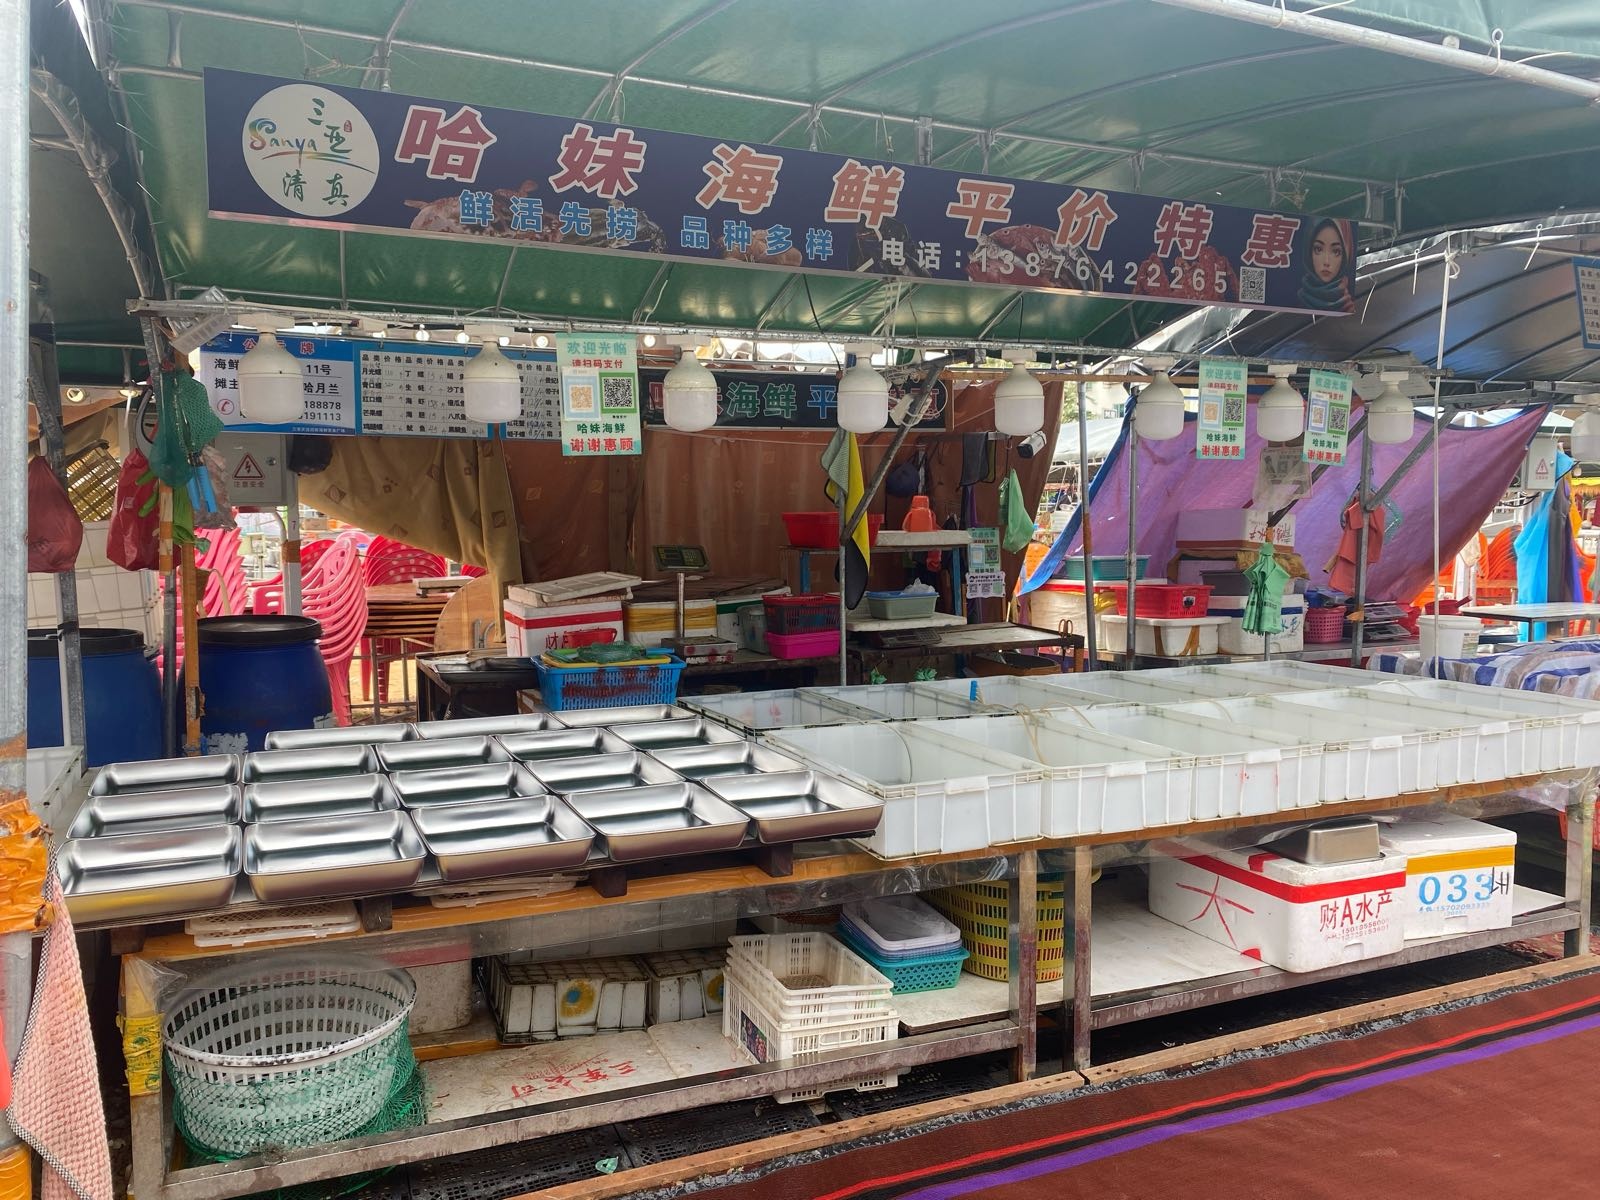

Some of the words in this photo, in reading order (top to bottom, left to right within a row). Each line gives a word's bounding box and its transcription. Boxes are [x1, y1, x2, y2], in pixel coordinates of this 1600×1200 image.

[249, 118, 317, 168] Sanya
[283, 169, 349, 206] 清真
[395, 105, 1299, 269] 哈妹海鲜平价特惠
[459, 189, 638, 241] 鲜活先捞
[681, 215, 833, 261] 品种多样
[567, 341, 627, 356] 欢迎光临
[306, 364, 332, 375] 11号
[572, 359, 623, 369] 请扫码支付
[303, 383, 339, 395] 哈月兰
[576, 423, 625, 434] 哈妹海鲜
[570, 437, 634, 452] 谢谢惠顾
[1202, 445, 1240, 457] 谢谢惠顾
[1419, 873, 1492, 905] 033
[1320, 889, 1392, 932] 财A水产
